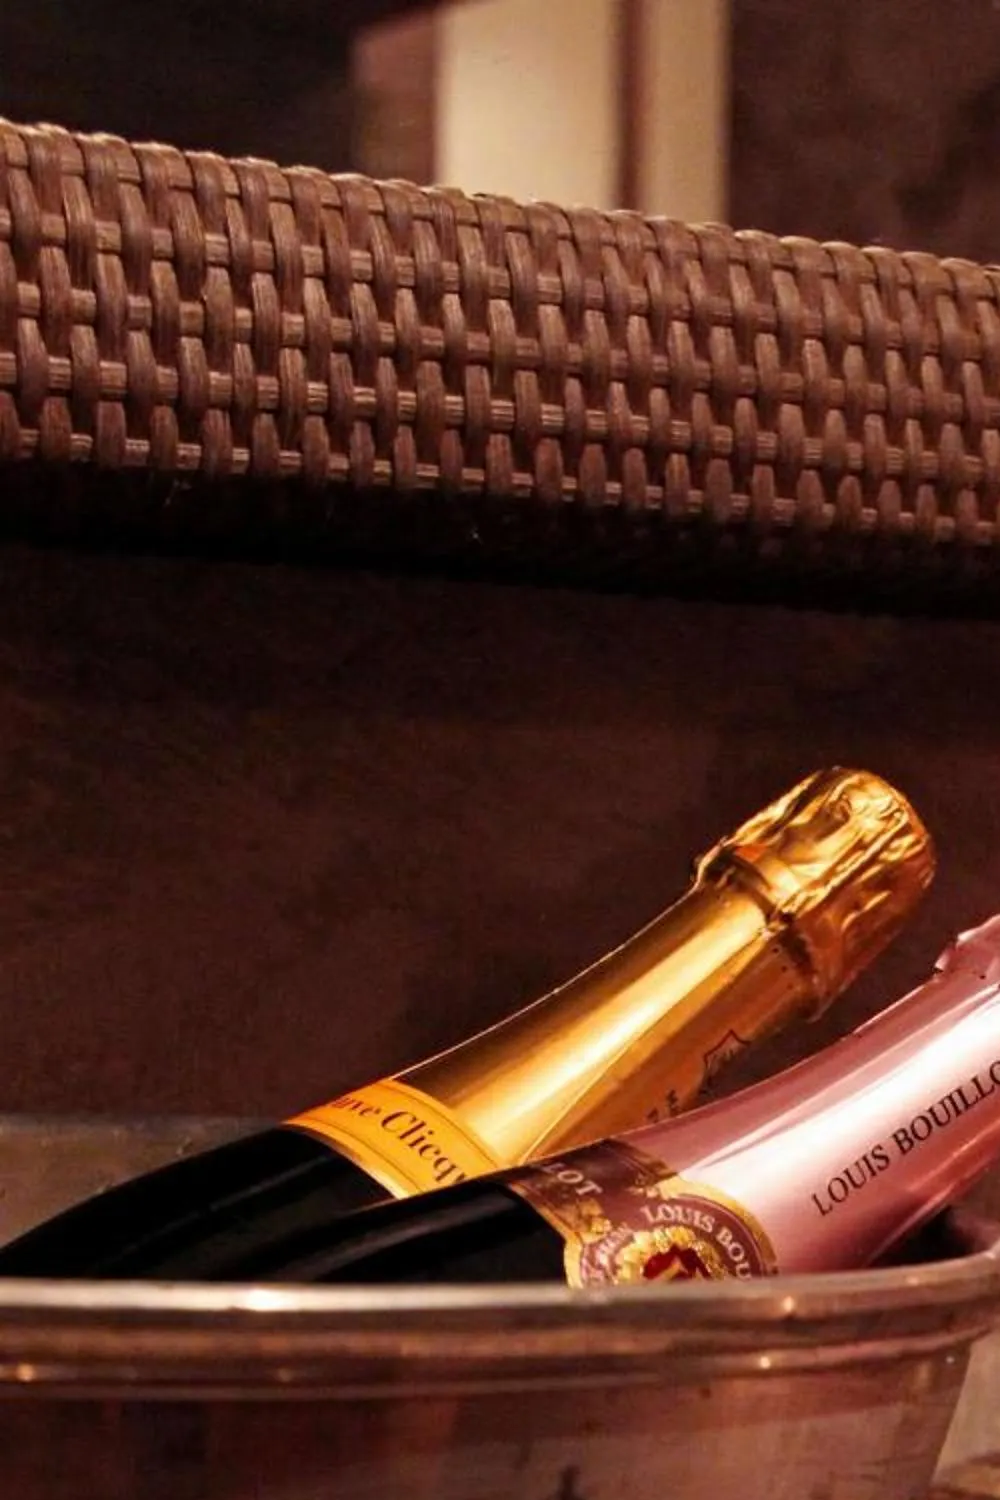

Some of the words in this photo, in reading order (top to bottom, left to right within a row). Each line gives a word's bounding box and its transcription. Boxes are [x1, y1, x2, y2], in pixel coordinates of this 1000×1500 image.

[541, 1162, 604, 1196] LOT
[811, 1144, 890, 1216] LOUIS
[640, 1203, 716, 1234] LOUIS
[715, 1224, 752, 1280] BOU
